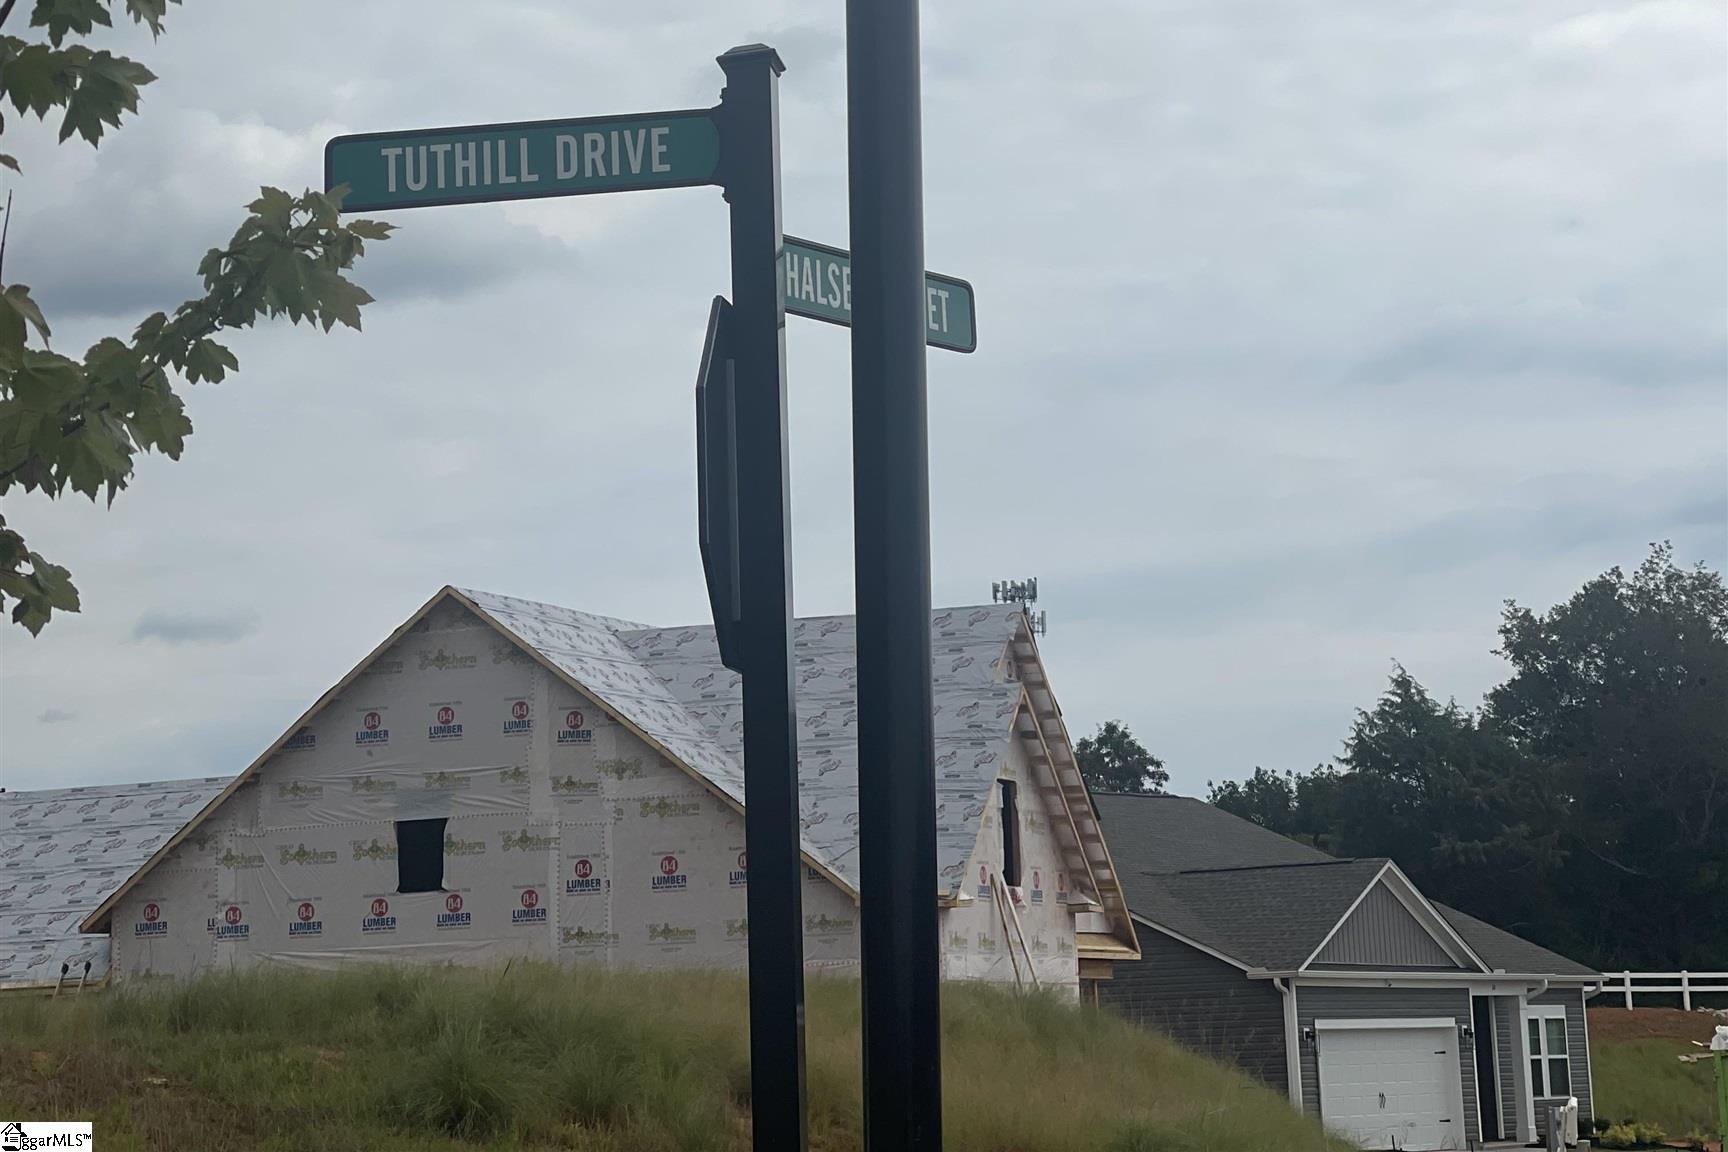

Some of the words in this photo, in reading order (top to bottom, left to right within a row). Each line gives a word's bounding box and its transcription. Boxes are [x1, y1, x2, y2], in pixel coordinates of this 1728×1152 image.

[381, 137, 539, 193] TUTHILL
[556, 127, 671, 180] DRIVE
[785, 252, 851, 311] HALSE
[439, 710, 452, 722] 84
[513, 705, 527, 717] 84
[366, 715, 379, 727] 84
[503, 719, 532, 730] LUMBE
[568, 714, 581, 726] 84
[355, 729, 389, 741] LUMBER
[429, 724, 463, 736] LUMBER
[557, 729, 592, 740] LUMBER
[577, 863, 590, 875] 84
[662, 859, 676, 871] 84
[566, 878, 601, 889] LUMBER
[652, 874, 687, 886] LUMBER
[448, 897, 461, 909] 84
[523, 893, 536, 905] 84
[299, 906, 313, 918] 84
[373, 902, 386, 913] 84
[512, 908, 547, 919] LUMBER
[362, 917, 396, 928] LUMBER
[437, 912, 471, 923] LUMBER
[135, 921, 168, 932] LUMBER
[216, 924, 249, 935] LUMBER
[289, 921, 322, 931] LUMBER
